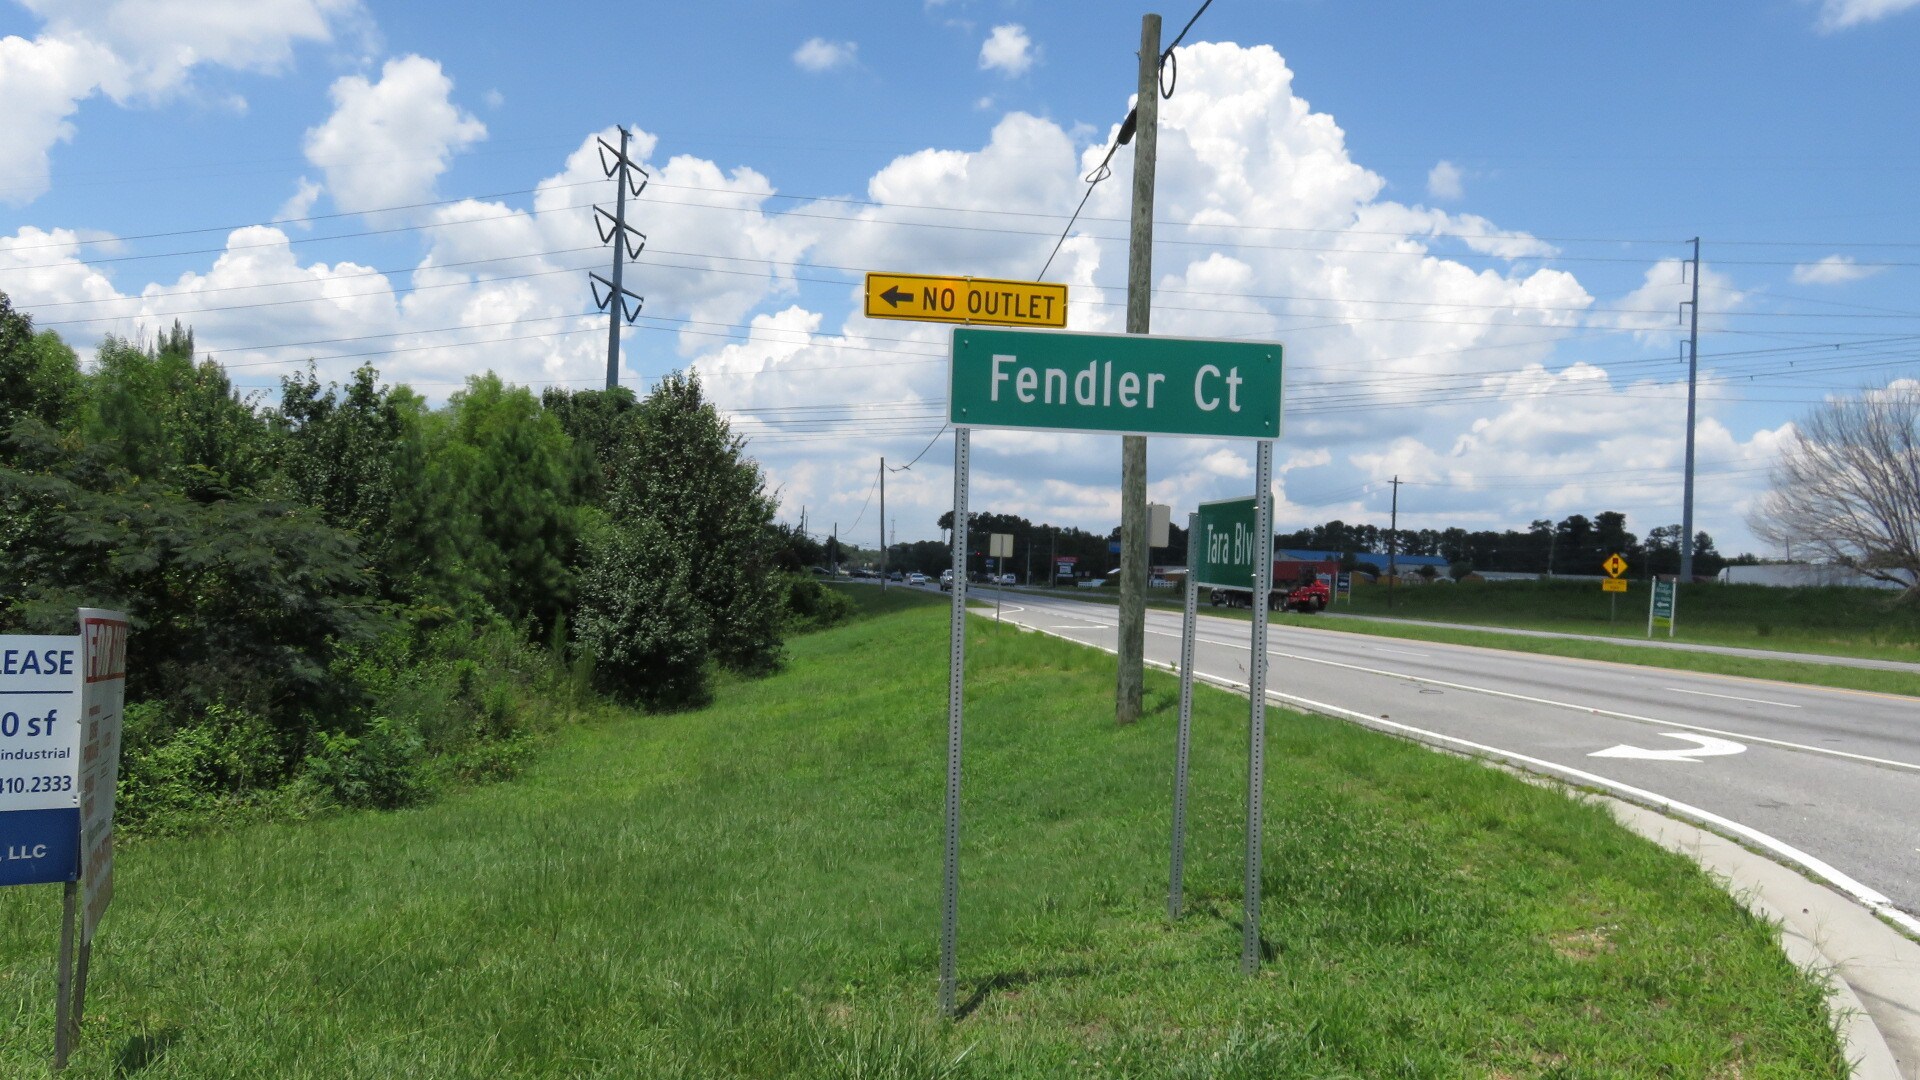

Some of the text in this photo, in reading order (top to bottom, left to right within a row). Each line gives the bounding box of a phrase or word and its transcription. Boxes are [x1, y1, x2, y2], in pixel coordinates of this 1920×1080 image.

[923, 286, 1056, 320] NO OUTLET
[991, 353, 1243, 413] Fendler Ct
[1207, 522, 1255, 566] Tara Blv
[0, 649, 74, 675] EASE
[27, 709, 57, 737] sf
[0, 747, 71, 760] industrial
[8, 844, 47, 860] LLC
